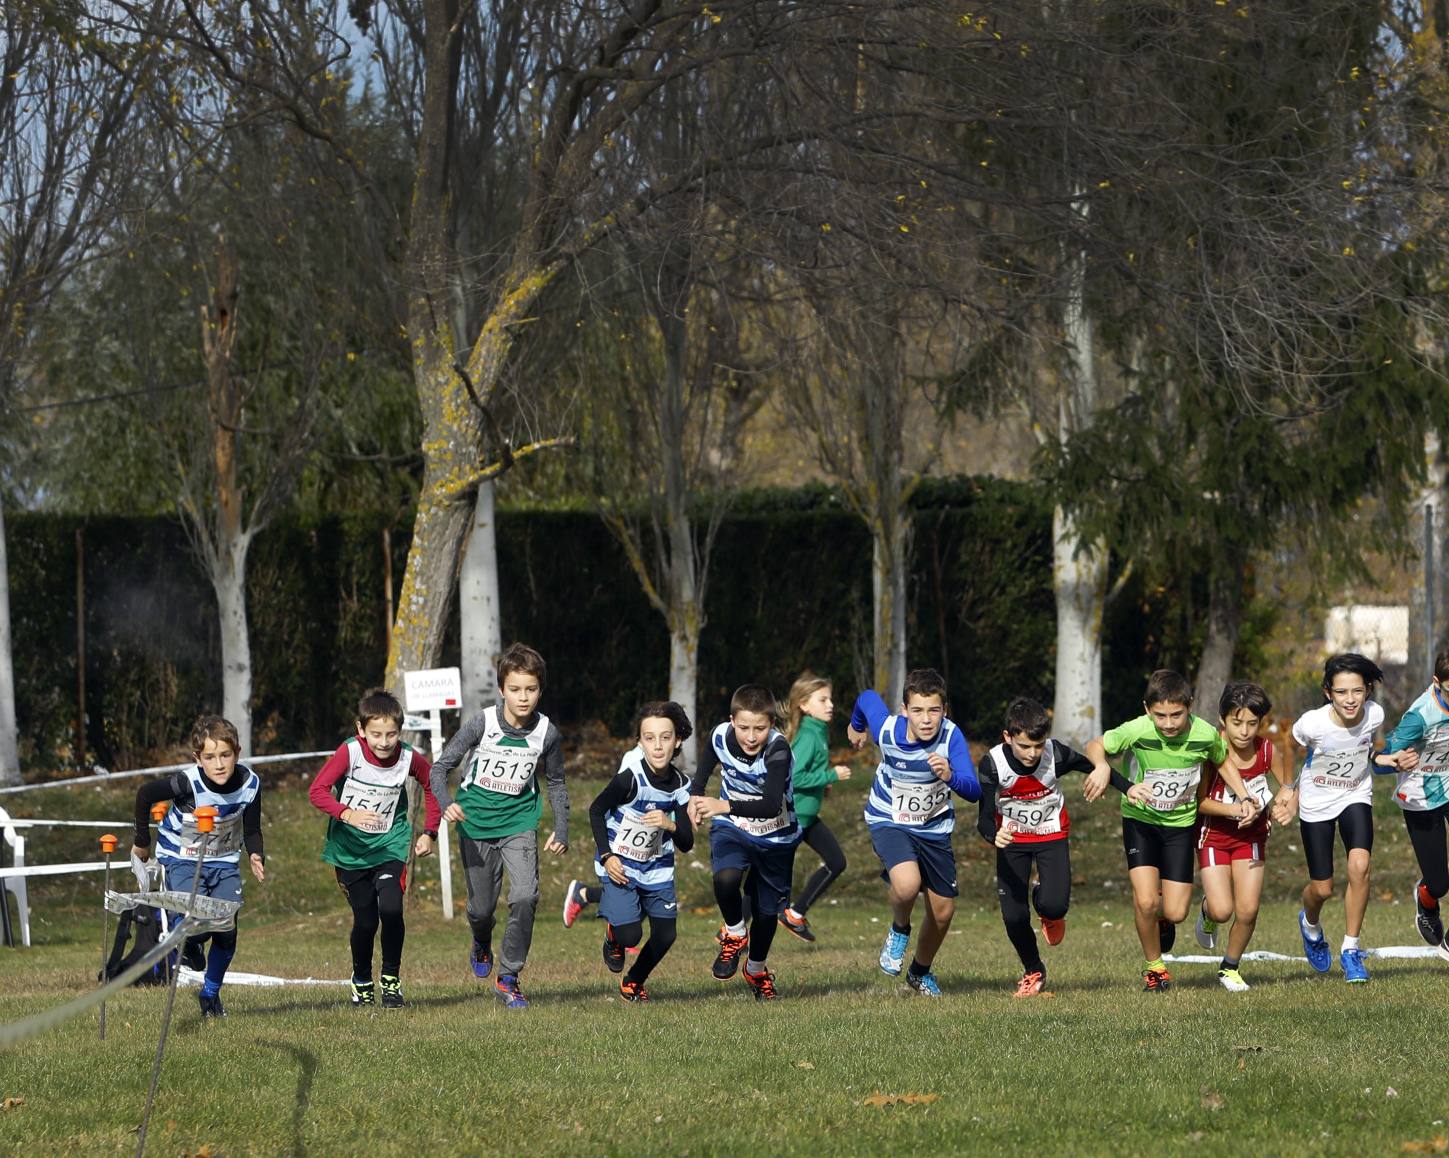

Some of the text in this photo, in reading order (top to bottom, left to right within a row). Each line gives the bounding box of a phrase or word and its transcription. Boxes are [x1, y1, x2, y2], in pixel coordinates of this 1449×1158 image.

[482, 759, 534, 780] 1513
[1326, 762, 1354, 778] 22
[346, 794, 394, 819] 1514
[896, 790, 945, 812] 1635
[1005, 806, 1055, 826] 1592
